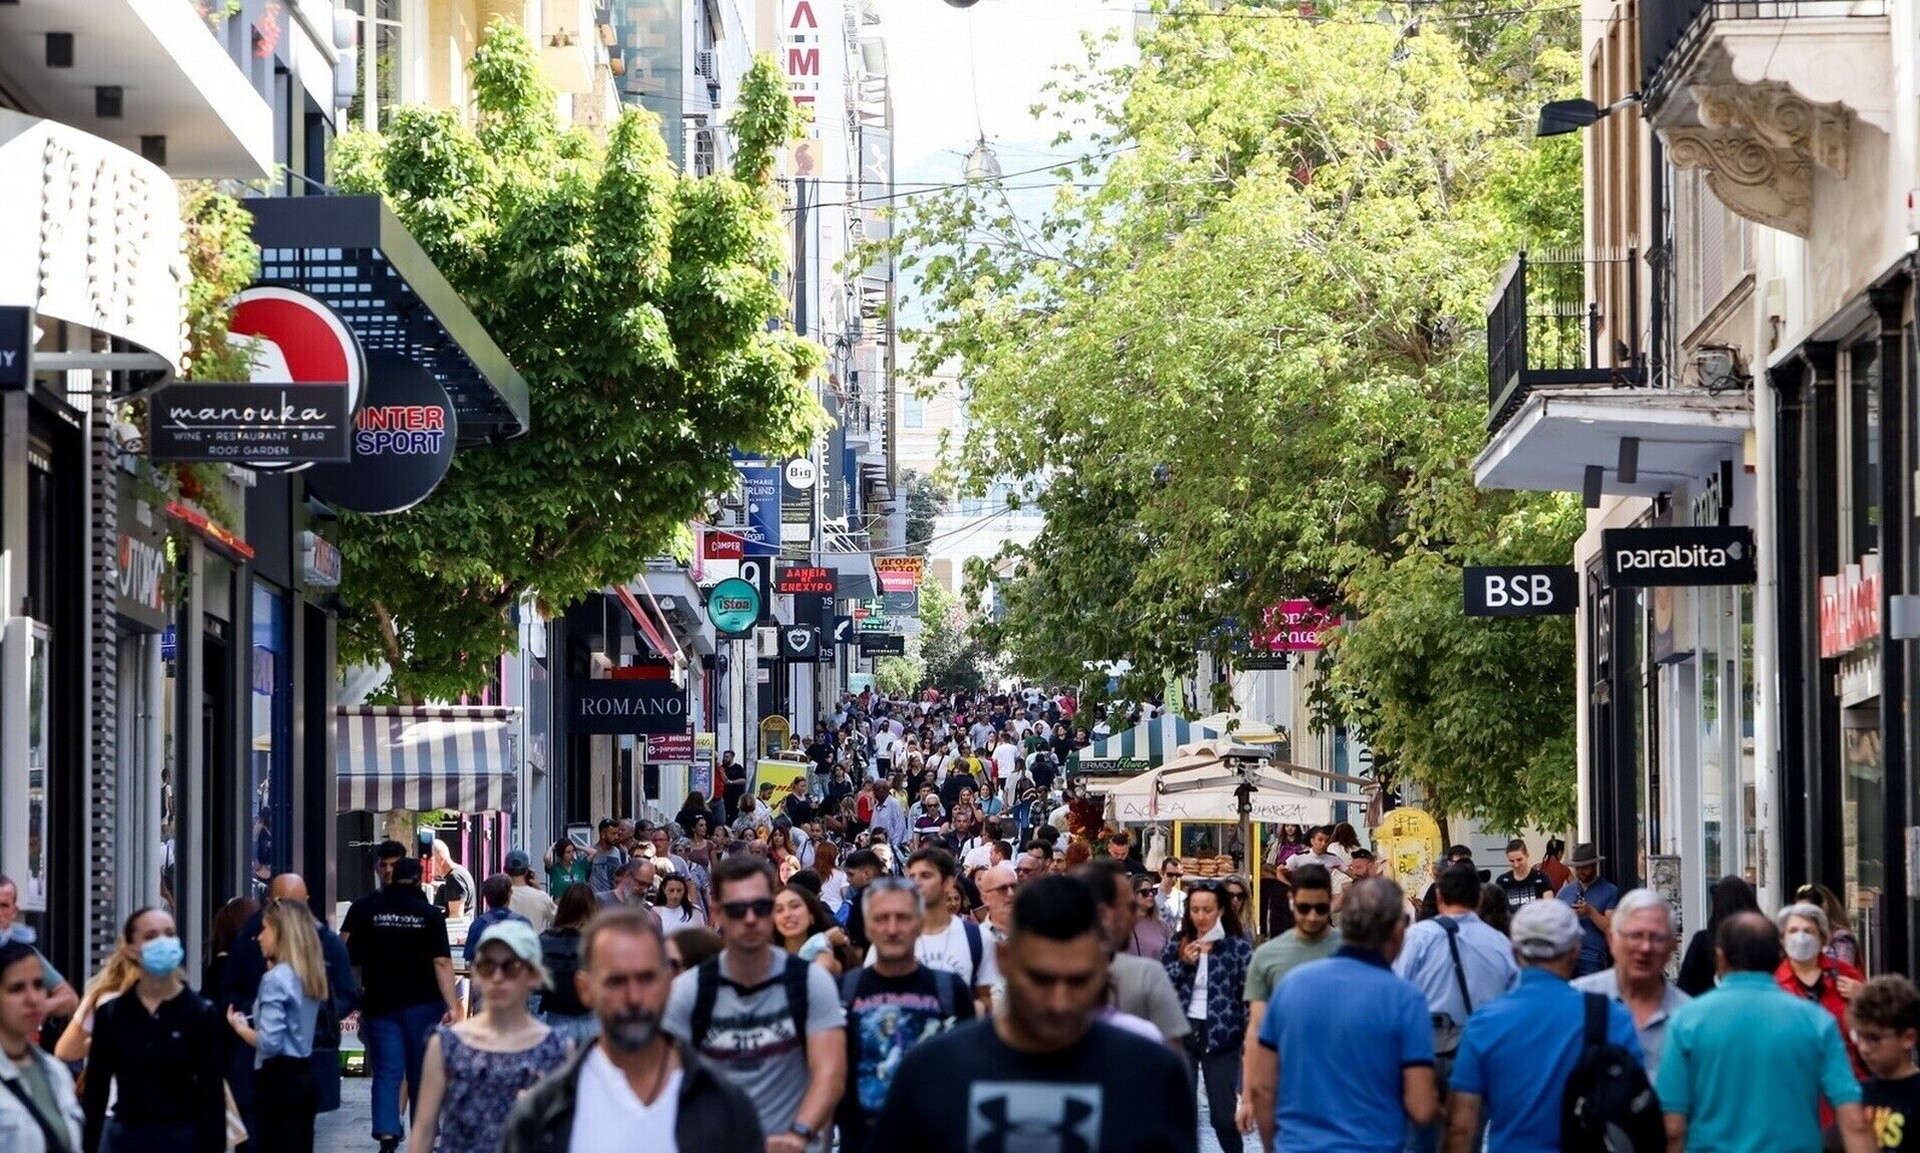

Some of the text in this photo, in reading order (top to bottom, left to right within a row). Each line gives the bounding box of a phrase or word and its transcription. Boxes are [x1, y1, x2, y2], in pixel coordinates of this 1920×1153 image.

[0, 350, 16, 367] Y
[170, 391, 326, 429] manouka
[357, 406, 445, 431] INTER
[174, 432, 325, 441] WINE RESTAURANT BAR
[356, 431, 445, 455] SPORT
[208, 446, 289, 455] ROOF GARDEN
[790, 467, 812, 478] Big
[747, 486, 776, 496] RLIND
[1616, 544, 1727, 573] parabita
[786, 568, 827, 578] ΔΑΝΕΙΑ
[780, 582, 833, 592] ΕΝΕΧΥΡΟ
[1485, 574, 1554, 608] BSB
[581, 698, 682, 716] ROMANO
[1080, 757, 1149, 770] ERMOU Flower
